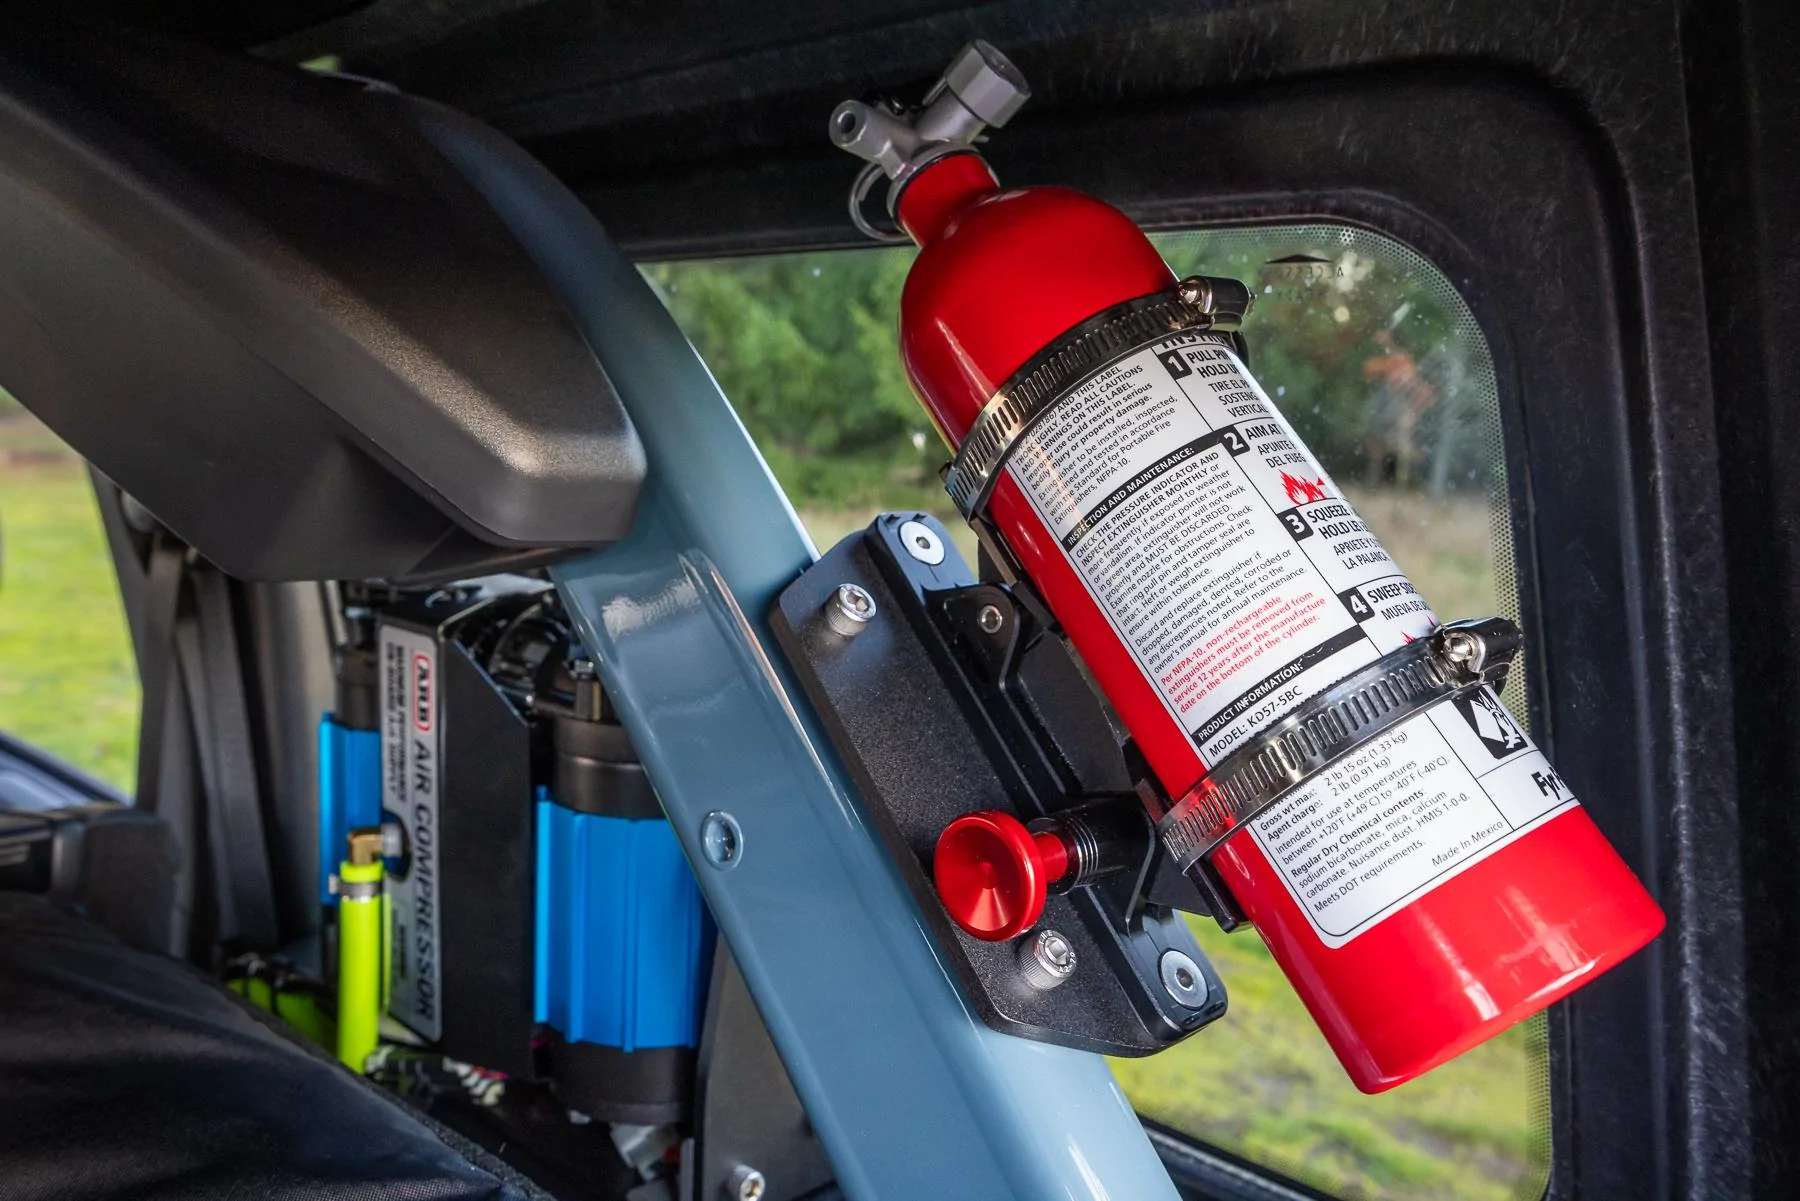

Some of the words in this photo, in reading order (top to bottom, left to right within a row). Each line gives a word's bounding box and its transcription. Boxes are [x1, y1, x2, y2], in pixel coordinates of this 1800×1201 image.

[1168, 355, 1184, 371] 1
[1185, 350, 1216, 364] PULL
[1197, 364, 1228, 378] HOLD
[1208, 381, 1232, 392] TIRE
[1230, 380, 1242, 389] EL
[1053, 440, 1067, 453] use
[1066, 421, 1088, 442] could
[1088, 405, 1113, 425] result
[1111, 399, 1122, 408] in
[1122, 382, 1152, 403] serious
[1059, 402, 1082, 422] READ
[1083, 391, 1100, 405] ALL
[1099, 364, 1143, 393] CAUTIONS
[1021, 457, 1034, 475] AND
[1072, 411, 1086, 424] ON
[1085, 397, 1106, 414] THIS
[1104, 381, 1135, 401] LABEL.
[1223, 432, 1244, 450] 2
[1245, 424, 1270, 440] AIM
[1267, 424, 1282, 435] AT
[1257, 440, 1290, 455] APUNTE
[1265, 455, 1287, 468] DEL
[1067, 504, 1107, 545] INSPECTION
[1108, 490, 1126, 508] AND
[1126, 447, 1194, 492] MAINTENANCE:
[1075, 534, 1098, 558] CHECK
[1095, 521, 1112, 537] THE
[1110, 490, 1151, 525] PRESSURE
[1150, 461, 1199, 494] INDICATOR
[1199, 451, 1219, 466] AND
[1095, 457, 1130, 484] NFPA-10.
[1080, 537, 1107, 567] INSPECT
[1106, 494, 1166, 542] EXTINGUISHER
[1164, 467, 1208, 497] MONTHLY
[1209, 463, 1219, 472] or
[1285, 514, 1305, 534] 3
[1306, 504, 1350, 523] SQUEEZE
[1318, 521, 1350, 539] HOLD
[1333, 538, 1368, 556] APRIETE
[1342, 557, 1359, 570] LA
[1367, 583, 1403, 604] SWEEP
[1128, 614, 1149, 635] ensure
[1148, 595, 1173, 616] within
[1171, 568, 1212, 597] tolerance.
[1134, 621, 1160, 647] Discard
[1158, 610, 1174, 626] and
[1172, 590, 1202, 614] replace
[1202, 557, 1253, 592] extinguisher
[1253, 550, 1261, 560] if
[1141, 627, 1172, 656] dropped,
[1171, 597, 1210, 630] damaged,
[1210, 576, 1243, 600] dented,
[1243, 552, 1282, 578] corroded
[1281, 549, 1291, 557] or
[1147, 651, 1160, 665] any
[1159, 614, 1207, 654] discrepancies
[1206, 595, 1234, 617] noted.
[1233, 580, 1257, 597] Refer
[1257, 574, 1268, 582] to
[1268, 565, 1284, 576] the
[1153, 648, 1180, 673] owner's
[1178, 625, 1208, 652] manual
[1206, 616, 1220, 629] for
[1221, 596, 1251, 619] annual
[1251, 567, 1306, 600] maintenance.
[1350, 594, 1369, 614] 4
[1380, 603, 1412, 621] MUEVA
[1160, 673, 1173, 686] Per
[1171, 647, 1206, 676] NFPA-10,
[1205, 596, 1281, 649] non-rechargeable
[1167, 653, 1216, 694] extinguishers
[1216, 636, 1238, 655] must
[1237, 629, 1250, 639] be
[1251, 602, 1291, 630] removed
[1290, 592, 1313, 606] from
[1173, 681, 1198, 704] service
[1197, 672, 1208, 683] 12
[1207, 656, 1230, 677] years
[1231, 640, 1252, 658] after
[1253, 630, 1270, 642] the
[1270, 598, 1325, 632] manufacture
[1180, 697, 1196, 713] date
[1195, 689, 1207, 699] on
[1206, 678, 1221, 690] the
[1219, 654, 1253, 680] bottom
[1253, 645, 1264, 656] of
[1264, 637, 1280, 648] the
[1282, 615, 1319, 638] cylinder.
[416, 661, 430, 725] ARB
[1198, 707, 1234, 740] PRODUCT
[1233, 661, 1303, 712] INFORMATION:
[1208, 724, 1248, 757] MODEL:
[1246, 685, 1303, 727] KD57-5BC
[415, 741, 431, 793] AIR
[1260, 812, 1282, 831] Gross
[1280, 803, 1295, 815] wt
[1324, 777, 1332, 786] 2
[1331, 771, 1342, 781] lb
[1343, 762, 1355, 773] 15
[1356, 755, 1367, 766] oz
[1390, 731, 1407, 744] kg)
[1267, 820, 1292, 842] Agent
[1291, 799, 1323, 824] charge:
[1330, 787, 1339, 796] 2
[1338, 782, 1350, 791] lb
[1373, 755, 1390, 769] kg)
[1274, 824, 1311, 854] Intended
[1310, 816, 1325, 829] for
[1326, 806, 1342, 819] use
[1343, 798, 1354, 808] at
[1353, 760, 1416, 800] temperatures
[1281, 837, 1318, 865] between
[1380, 790, 1392, 799] to
[1298, 865, 1328, 888] sodium
[1325, 830, 1384, 868] bicarbonate,
[1385, 814, 1411, 831] mica,
[1412, 791, 1447, 815] calcium
[1290, 853, 1322, 878] Regular
[1321, 842, 1339, 857] Dry
[1339, 813, 1382, 844] Chemical
[1306, 868, 1349, 898] carbonate.
[1348, 840, 1391, 869] Nuisance
[1391, 825, 1416, 842] dust.
[1415, 807, 1442, 827] HMIS
[1442, 792, 1470, 810] 1-0-0.
[1313, 892, 1340, 912] Meets
[1338, 877, 1358, 895] DOT
[1359, 840, 1424, 882] requirements.
[1431, 846, 1458, 866] Made
[1460, 840, 1470, 849] In
[1471, 821, 1503, 842] Mexico
[415, 803, 434, 1020] COMPRESSOR
